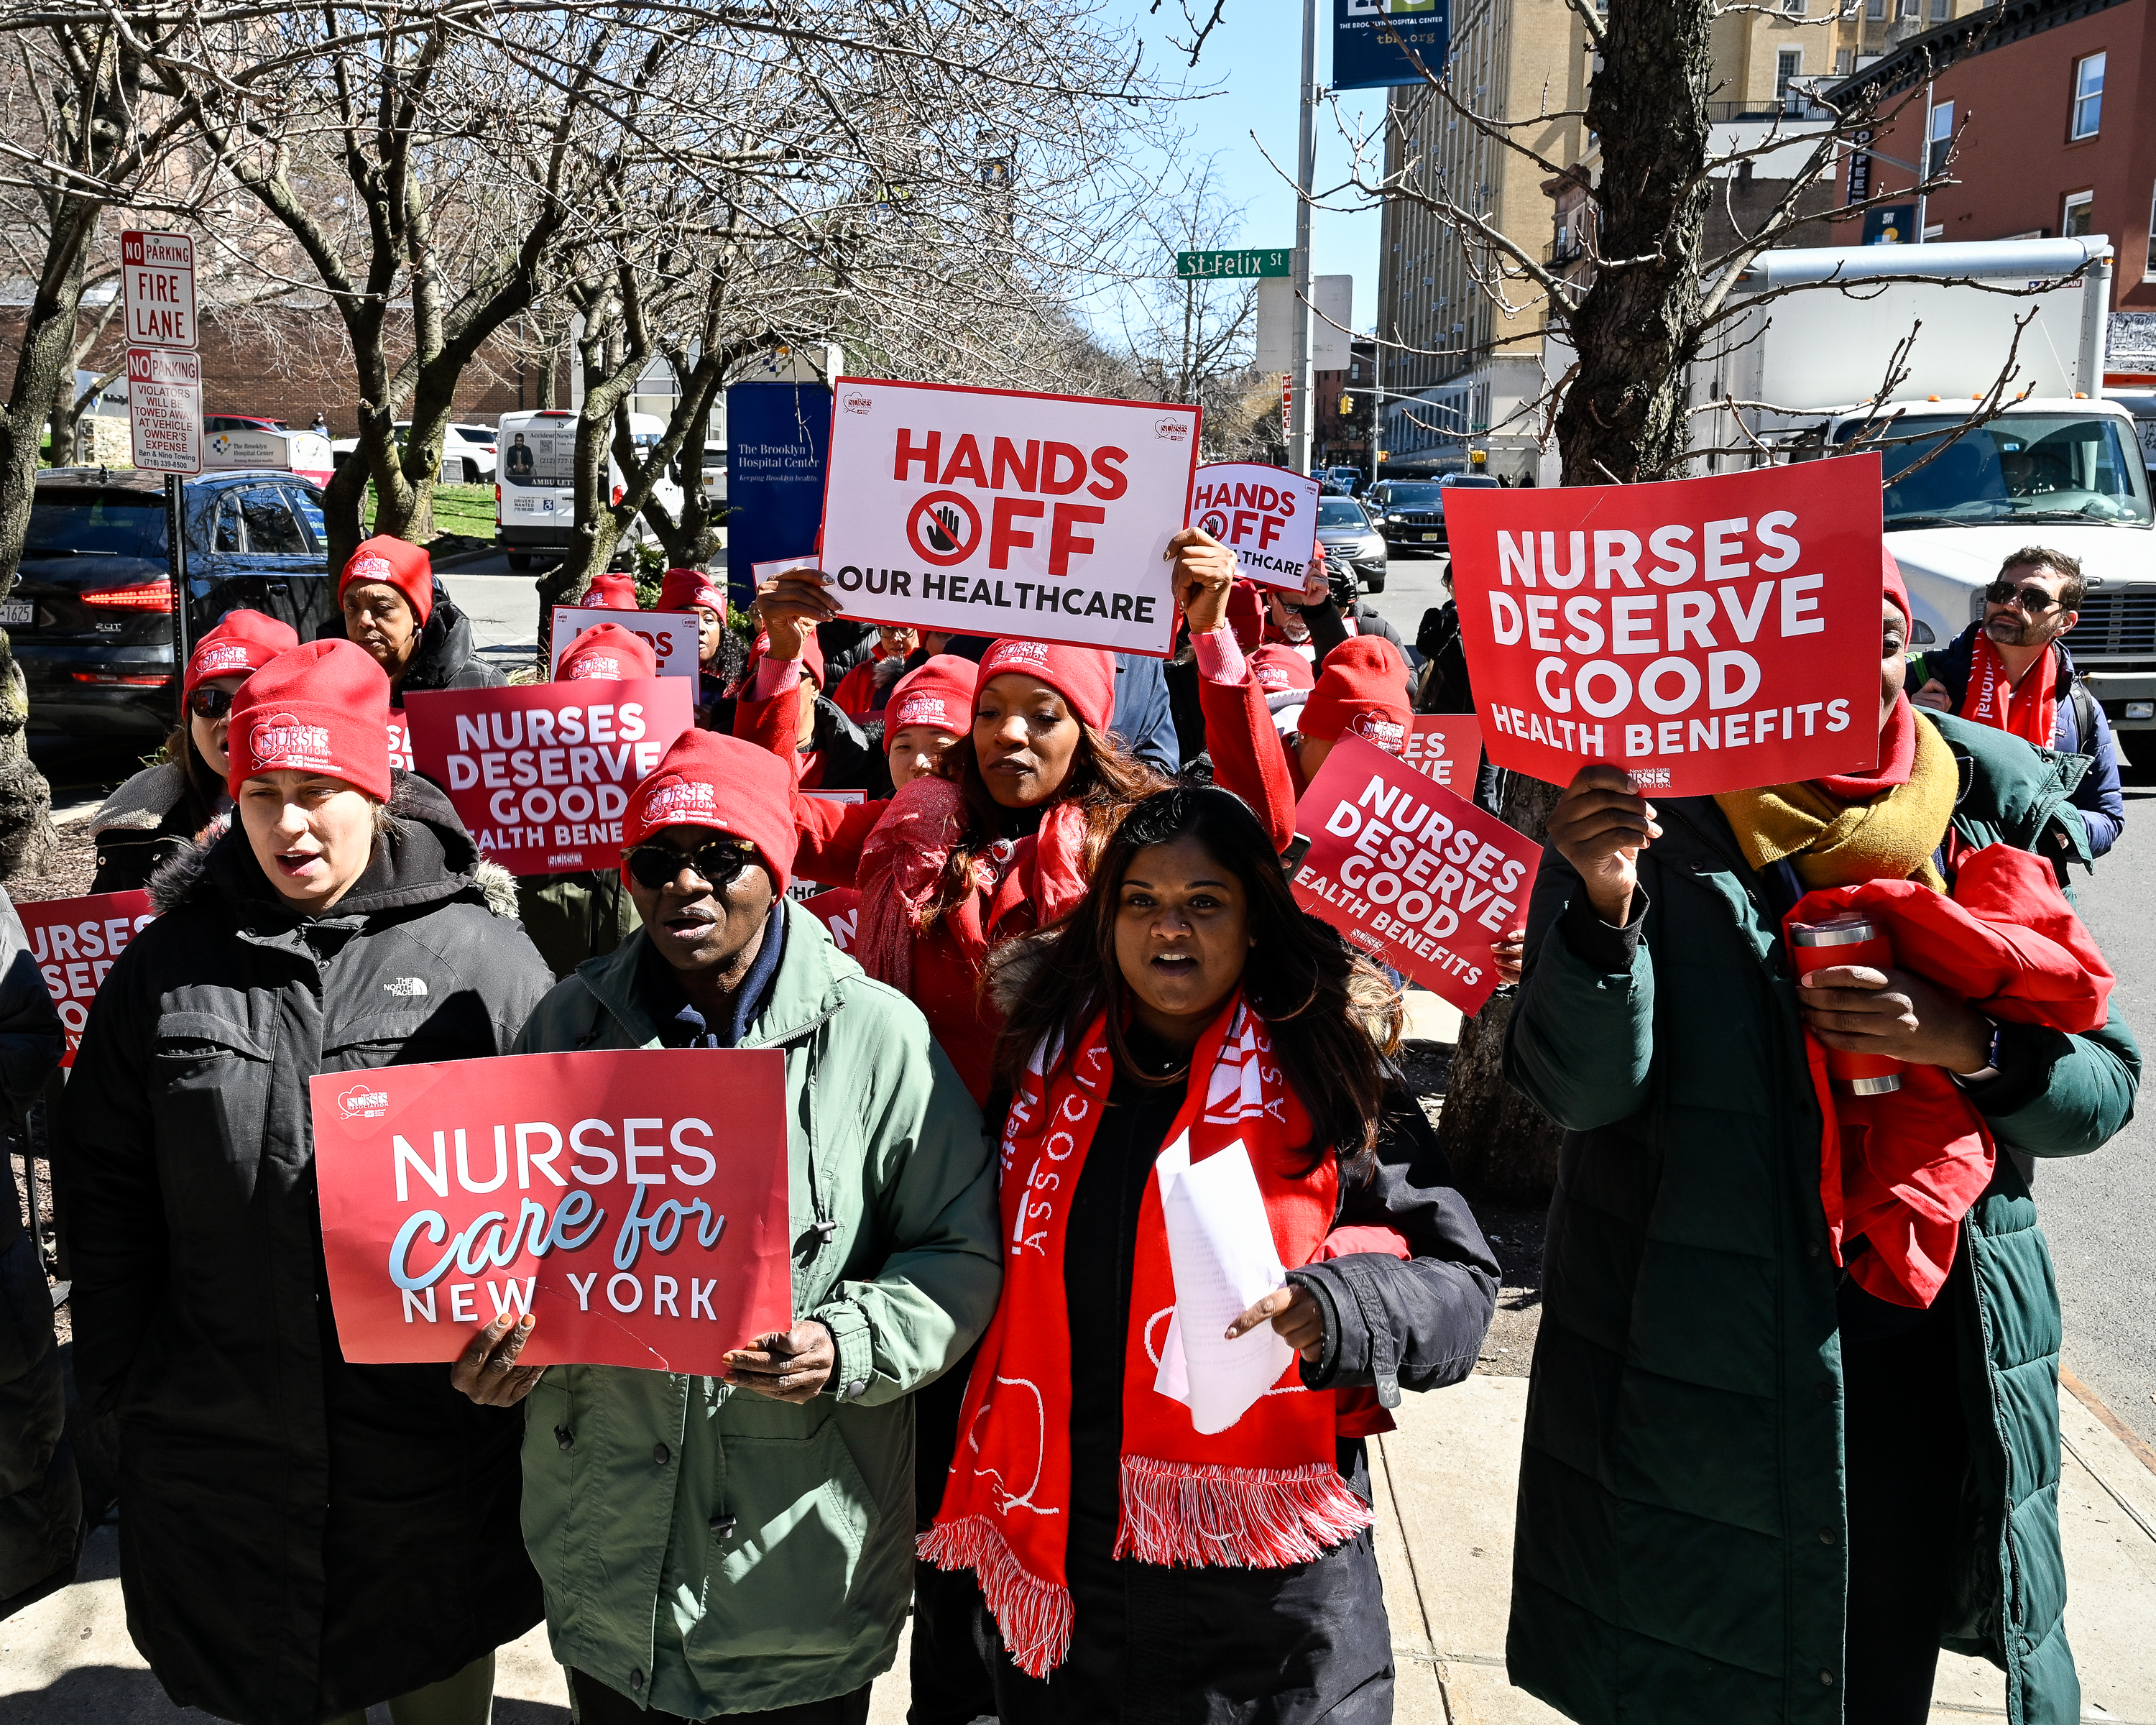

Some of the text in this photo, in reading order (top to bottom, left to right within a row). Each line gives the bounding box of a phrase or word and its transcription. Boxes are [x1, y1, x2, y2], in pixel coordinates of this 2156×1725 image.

[1853, 131, 1870, 189] OFEE
[125, 242, 189, 262] NO PARKING
[1187, 252, 1282, 276] St Felix St
[138, 272, 180, 303] FIRE
[137, 308, 185, 339] LANE
[129, 354, 195, 379] NO PARKING
[137, 385, 190, 398] VIOLATORS
[146, 397, 183, 409] WILL BE
[134, 406, 194, 420] TOWED AWAY
[138, 418, 193, 431] AT VEHICLE
[144, 429, 187, 441] OWNER'S
[145, 440, 188, 452] EXPENSE
[738, 443, 806, 456] The Brooklyn
[144, 458, 187, 469] (718) 339-8500
[174, 452, 195, 462] Towing
[739, 457, 819, 469] Hospital Center
[894, 427, 1129, 502] HANDS
[1194, 482, 1296, 517] HANDS
[906, 490, 1105, 576] OFF
[1233, 549, 1304, 577] THCARE
[1496, 510, 1802, 590] NURSES
[837, 564, 1156, 625] OUR HEALTHCARE
[7, 606, 30, 622] 1625
[1488, 573, 1825, 655] DESERVE
[1535, 649, 1762, 719] GOOD
[1977, 657, 1994, 719] tional
[262, 732, 328, 748] NURSES
[308, 724, 328, 733] State
[456, 702, 647, 752] NURSES
[1363, 721, 1405, 739] NURSES
[1491, 702, 1604, 758] HEALTH
[1625, 698, 1851, 758] BENEFITS
[446, 740, 663, 792] DESERVE
[1627, 773, 1671, 784] RSES
[649, 788, 714, 810] NURSES
[691, 781, 714, 790] State
[489, 783, 628, 826] GOOD
[467, 821, 624, 851] ALTH BENE
[1358, 773, 1526, 894] NURSES
[1325, 799, 1516, 934] DESERVE
[1340, 855, 1460, 939] GOOD
[34, 914, 157, 962] URSE
[1294, 864, 1483, 987] EALTH BENEFITS
[1352, 927, 1384, 949] NURSES
[347, 1095, 388, 1107] NURSES
[999, 1088, 1038, 1186] Nati
[1024, 1046, 1108, 1256] ASSOCIA
[392, 1118, 717, 1202] NURSES
[613, 1182, 724, 1271] for
[401, 1273, 718, 1324] NEW YORK
